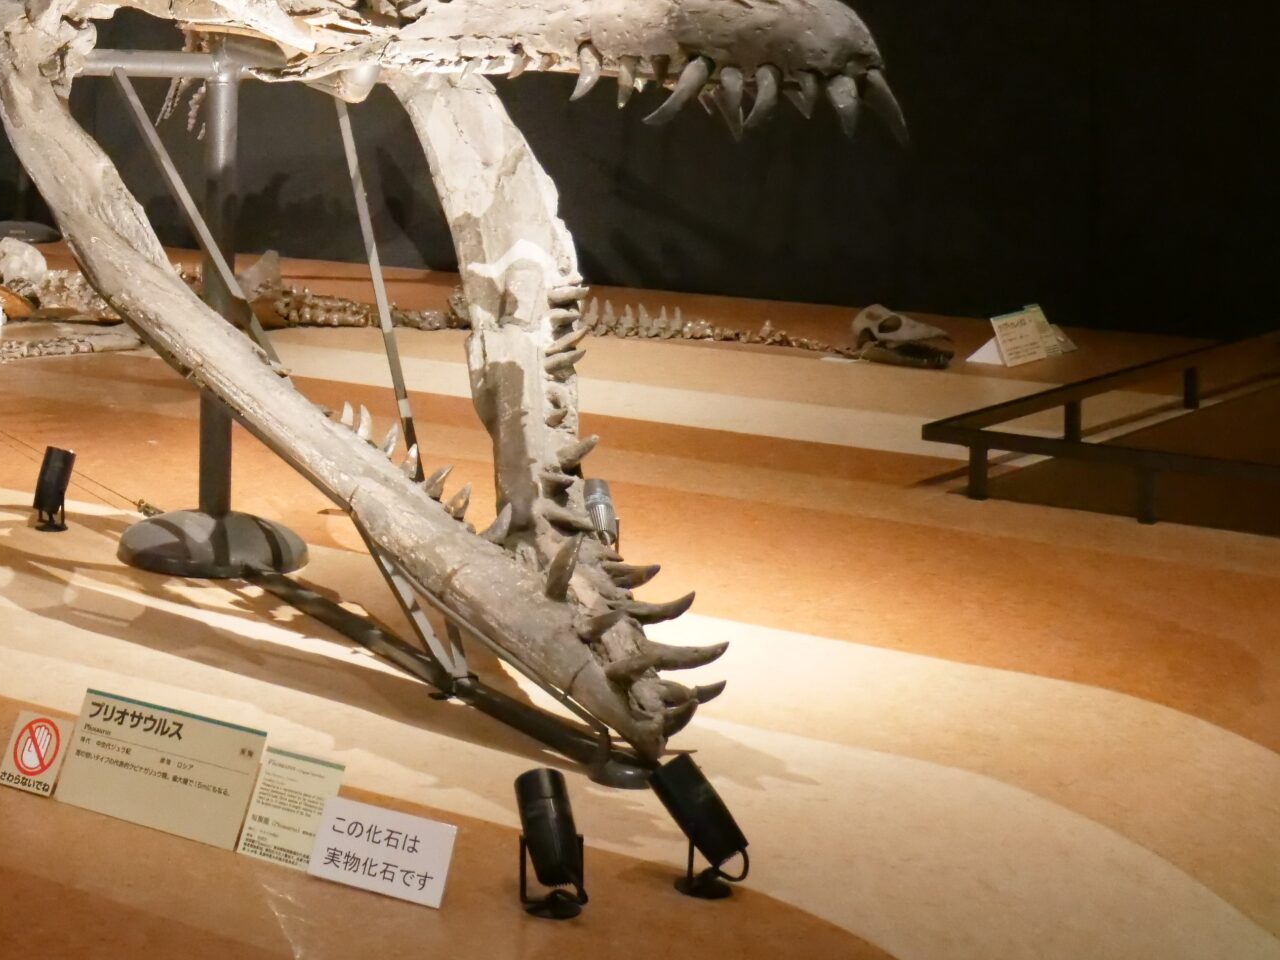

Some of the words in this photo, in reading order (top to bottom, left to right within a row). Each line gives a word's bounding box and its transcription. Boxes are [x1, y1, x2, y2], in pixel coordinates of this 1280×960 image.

[89, 701, 185, 740] プリオサウルス
[0, 770, 51, 792] さわらないでね
[332, 817, 421, 854] この化石は
[323, 847, 434, 891] 実物化石です
